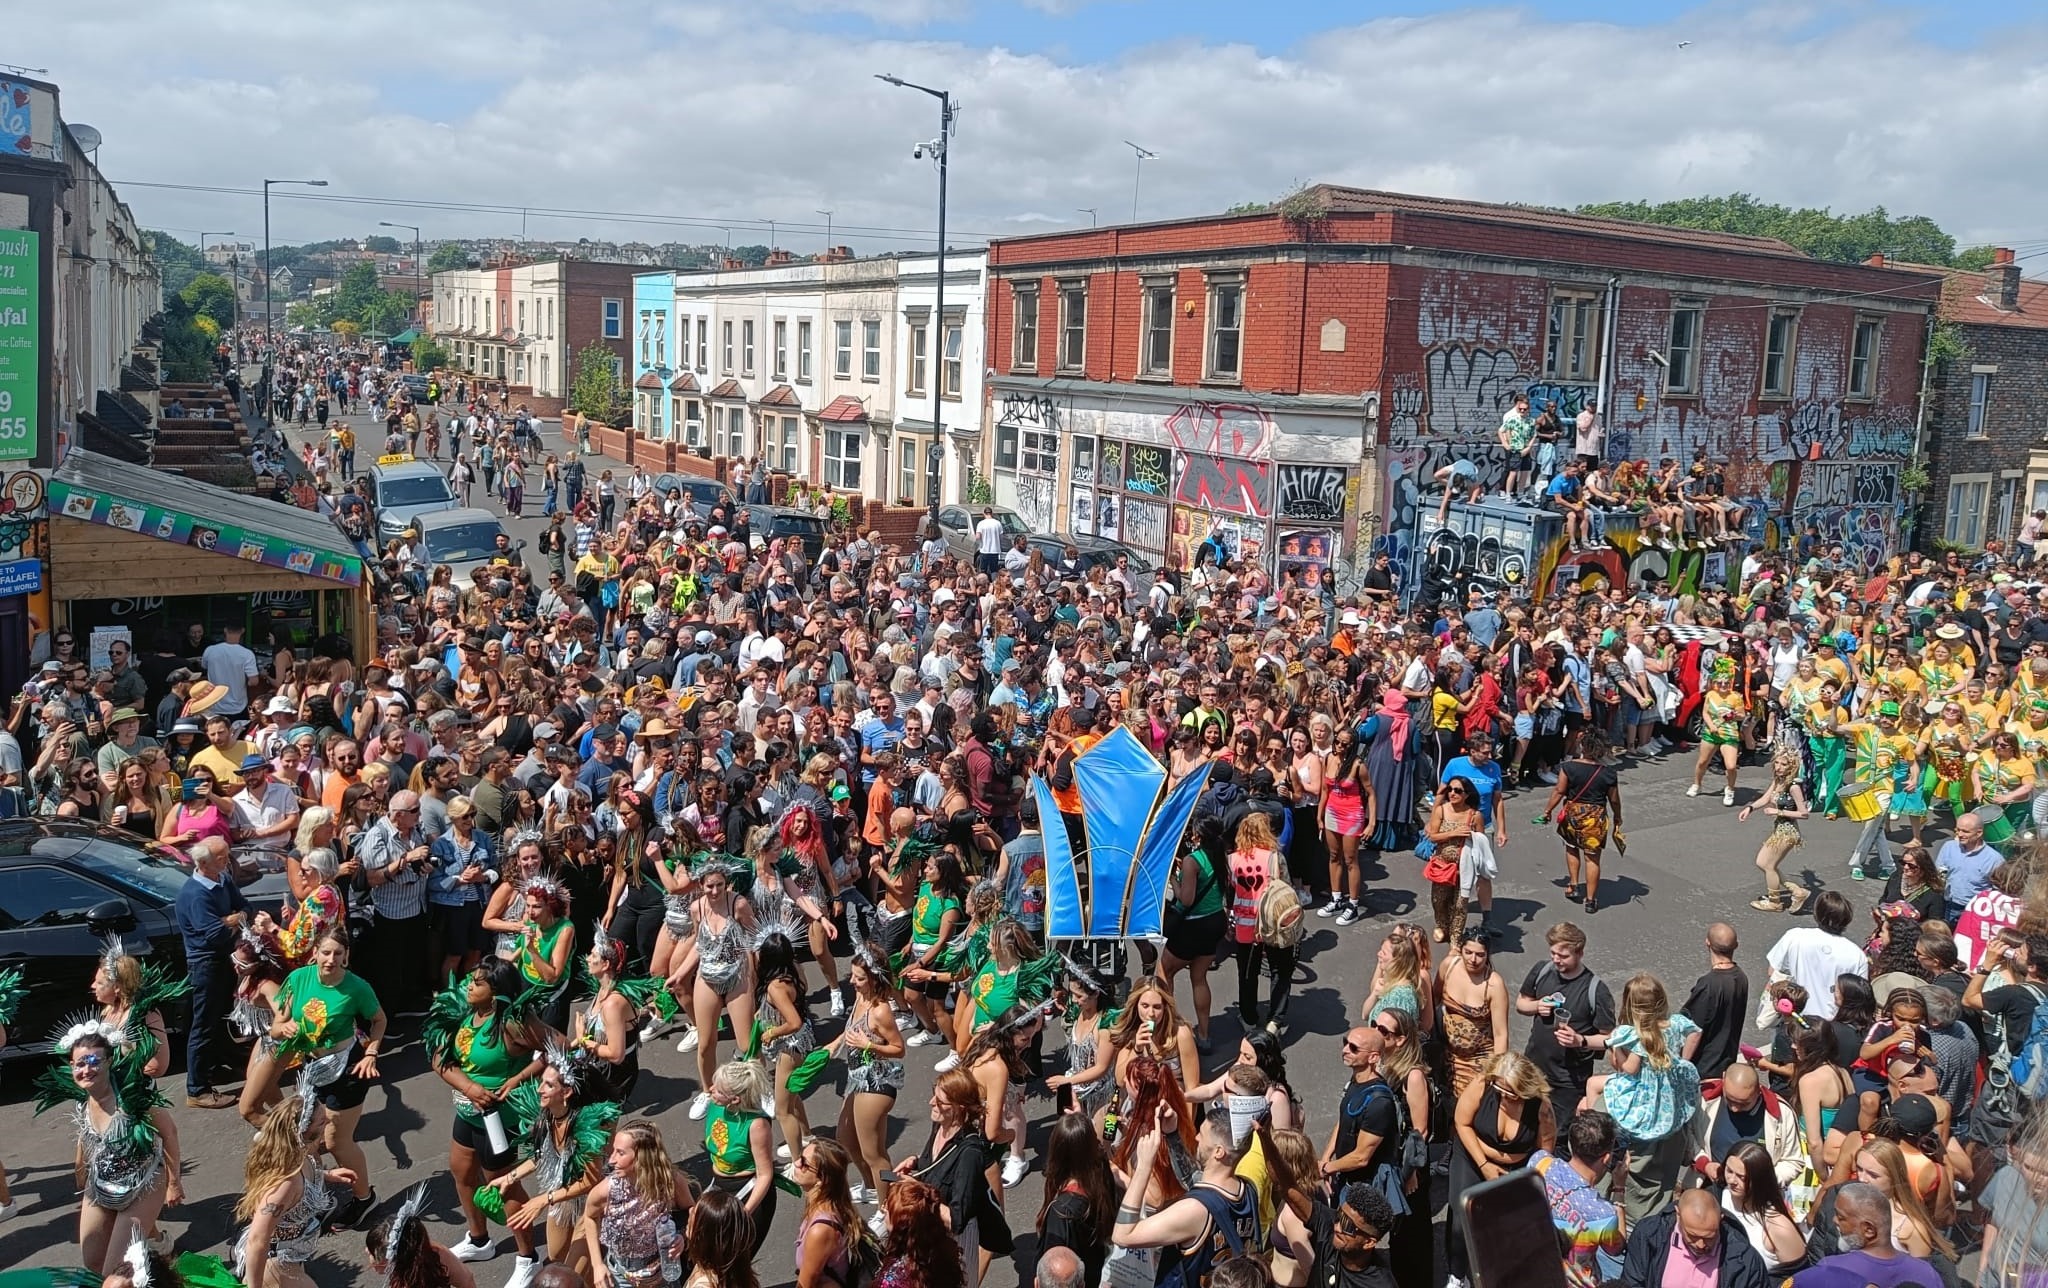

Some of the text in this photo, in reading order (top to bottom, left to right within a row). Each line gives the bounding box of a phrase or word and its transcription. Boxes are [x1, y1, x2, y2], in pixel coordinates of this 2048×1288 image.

[10, 336, 32, 348] Coffee
[0, 571, 38, 585] FALAFEL
[13, 582, 38, 592] WORLD
